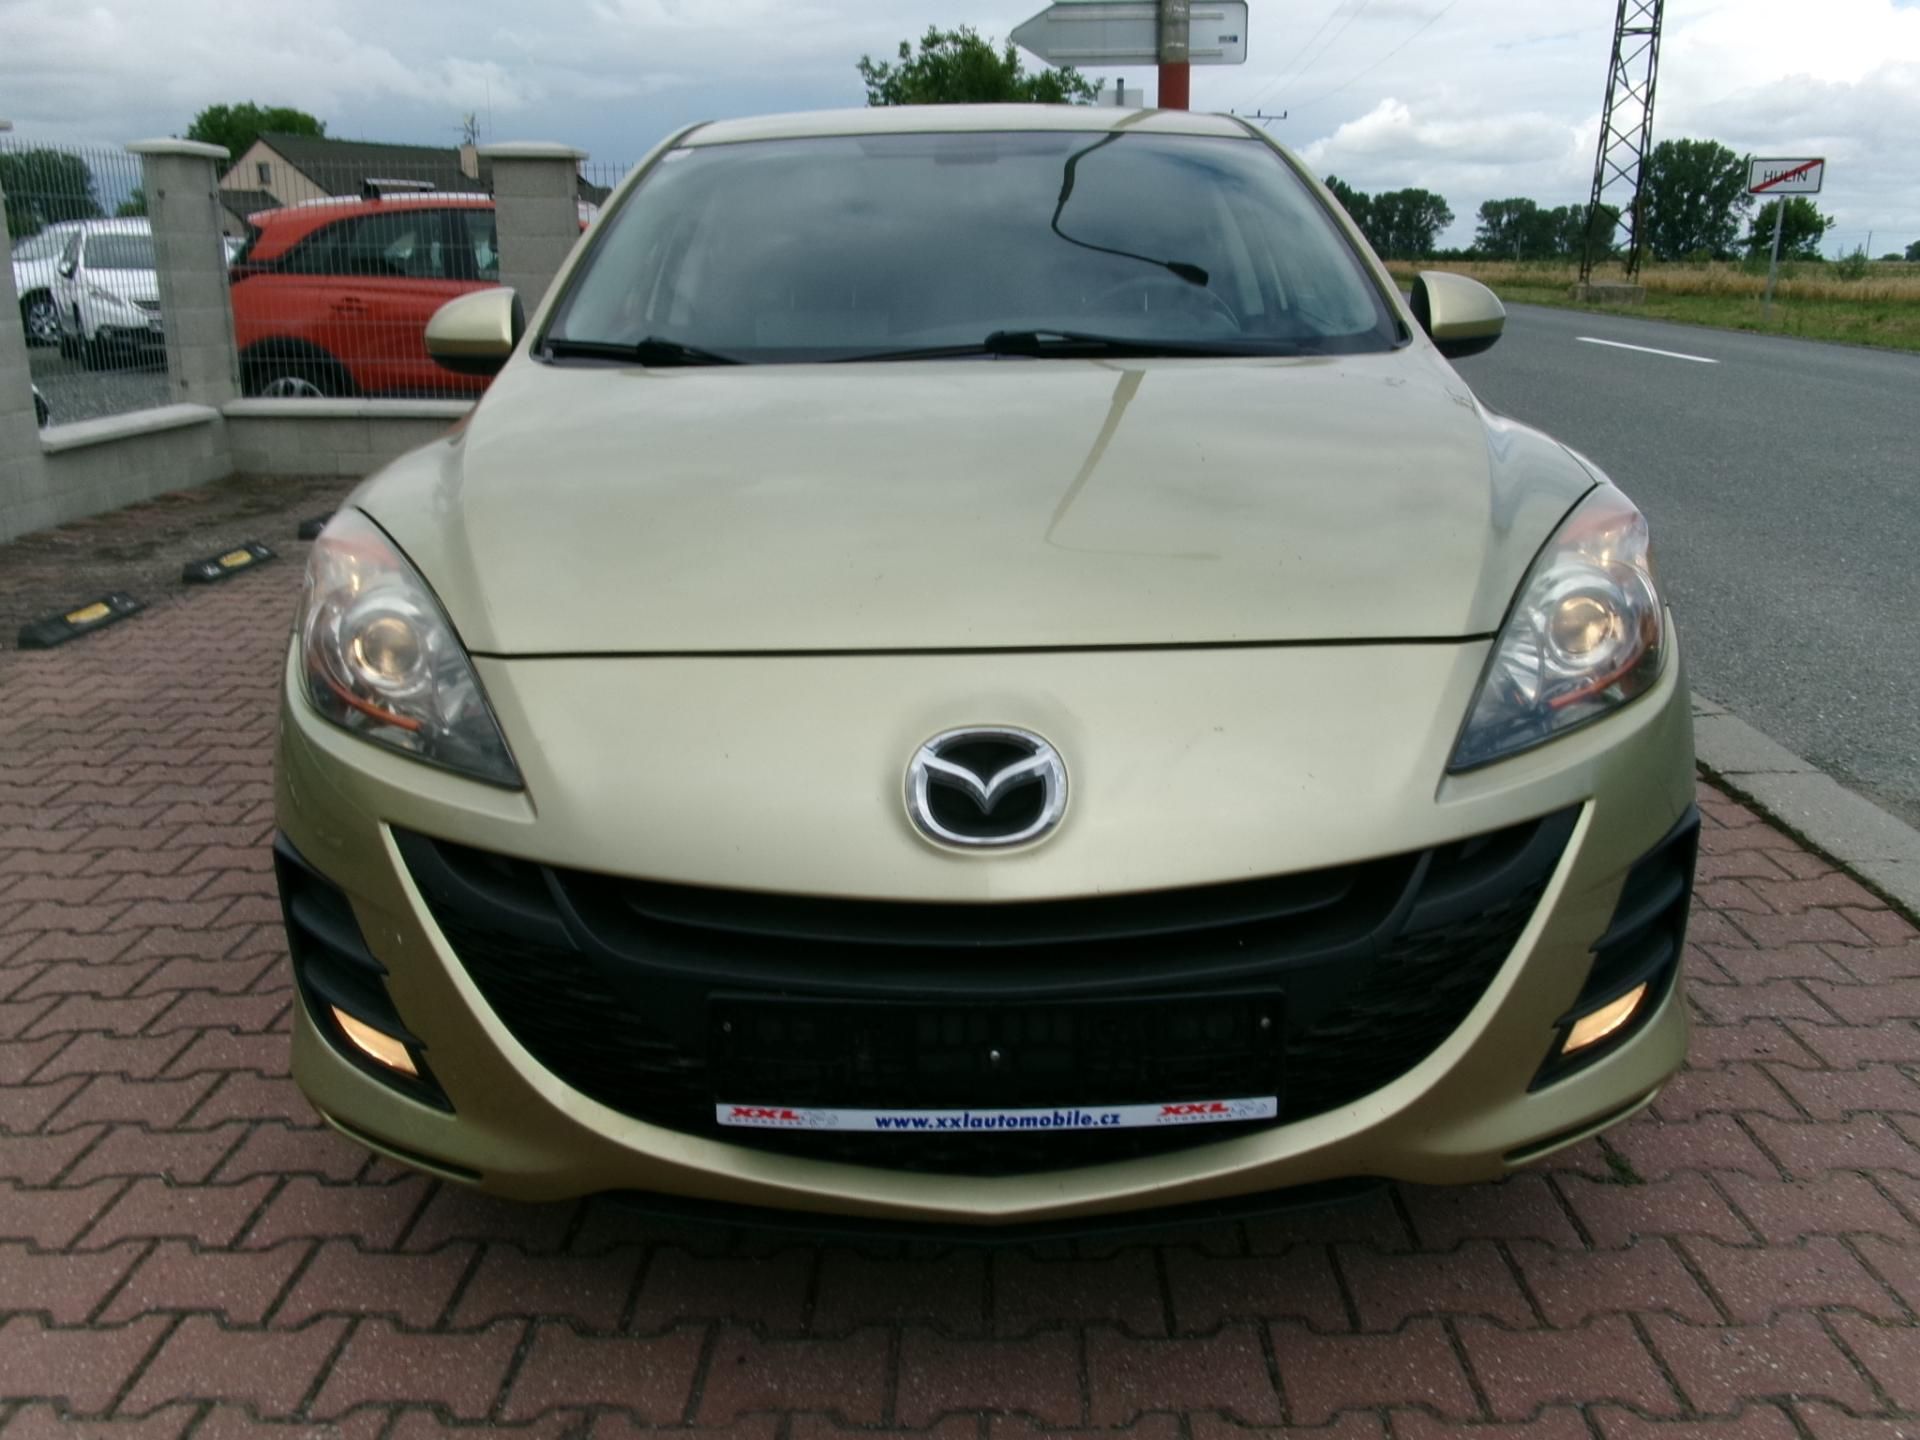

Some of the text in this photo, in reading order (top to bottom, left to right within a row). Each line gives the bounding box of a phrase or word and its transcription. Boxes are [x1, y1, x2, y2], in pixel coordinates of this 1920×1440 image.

[731, 1106, 800, 1120] XXL
[1160, 1101, 1230, 1116] XXL
[874, 1110, 1121, 1129] www.xxlautomobile.cz
